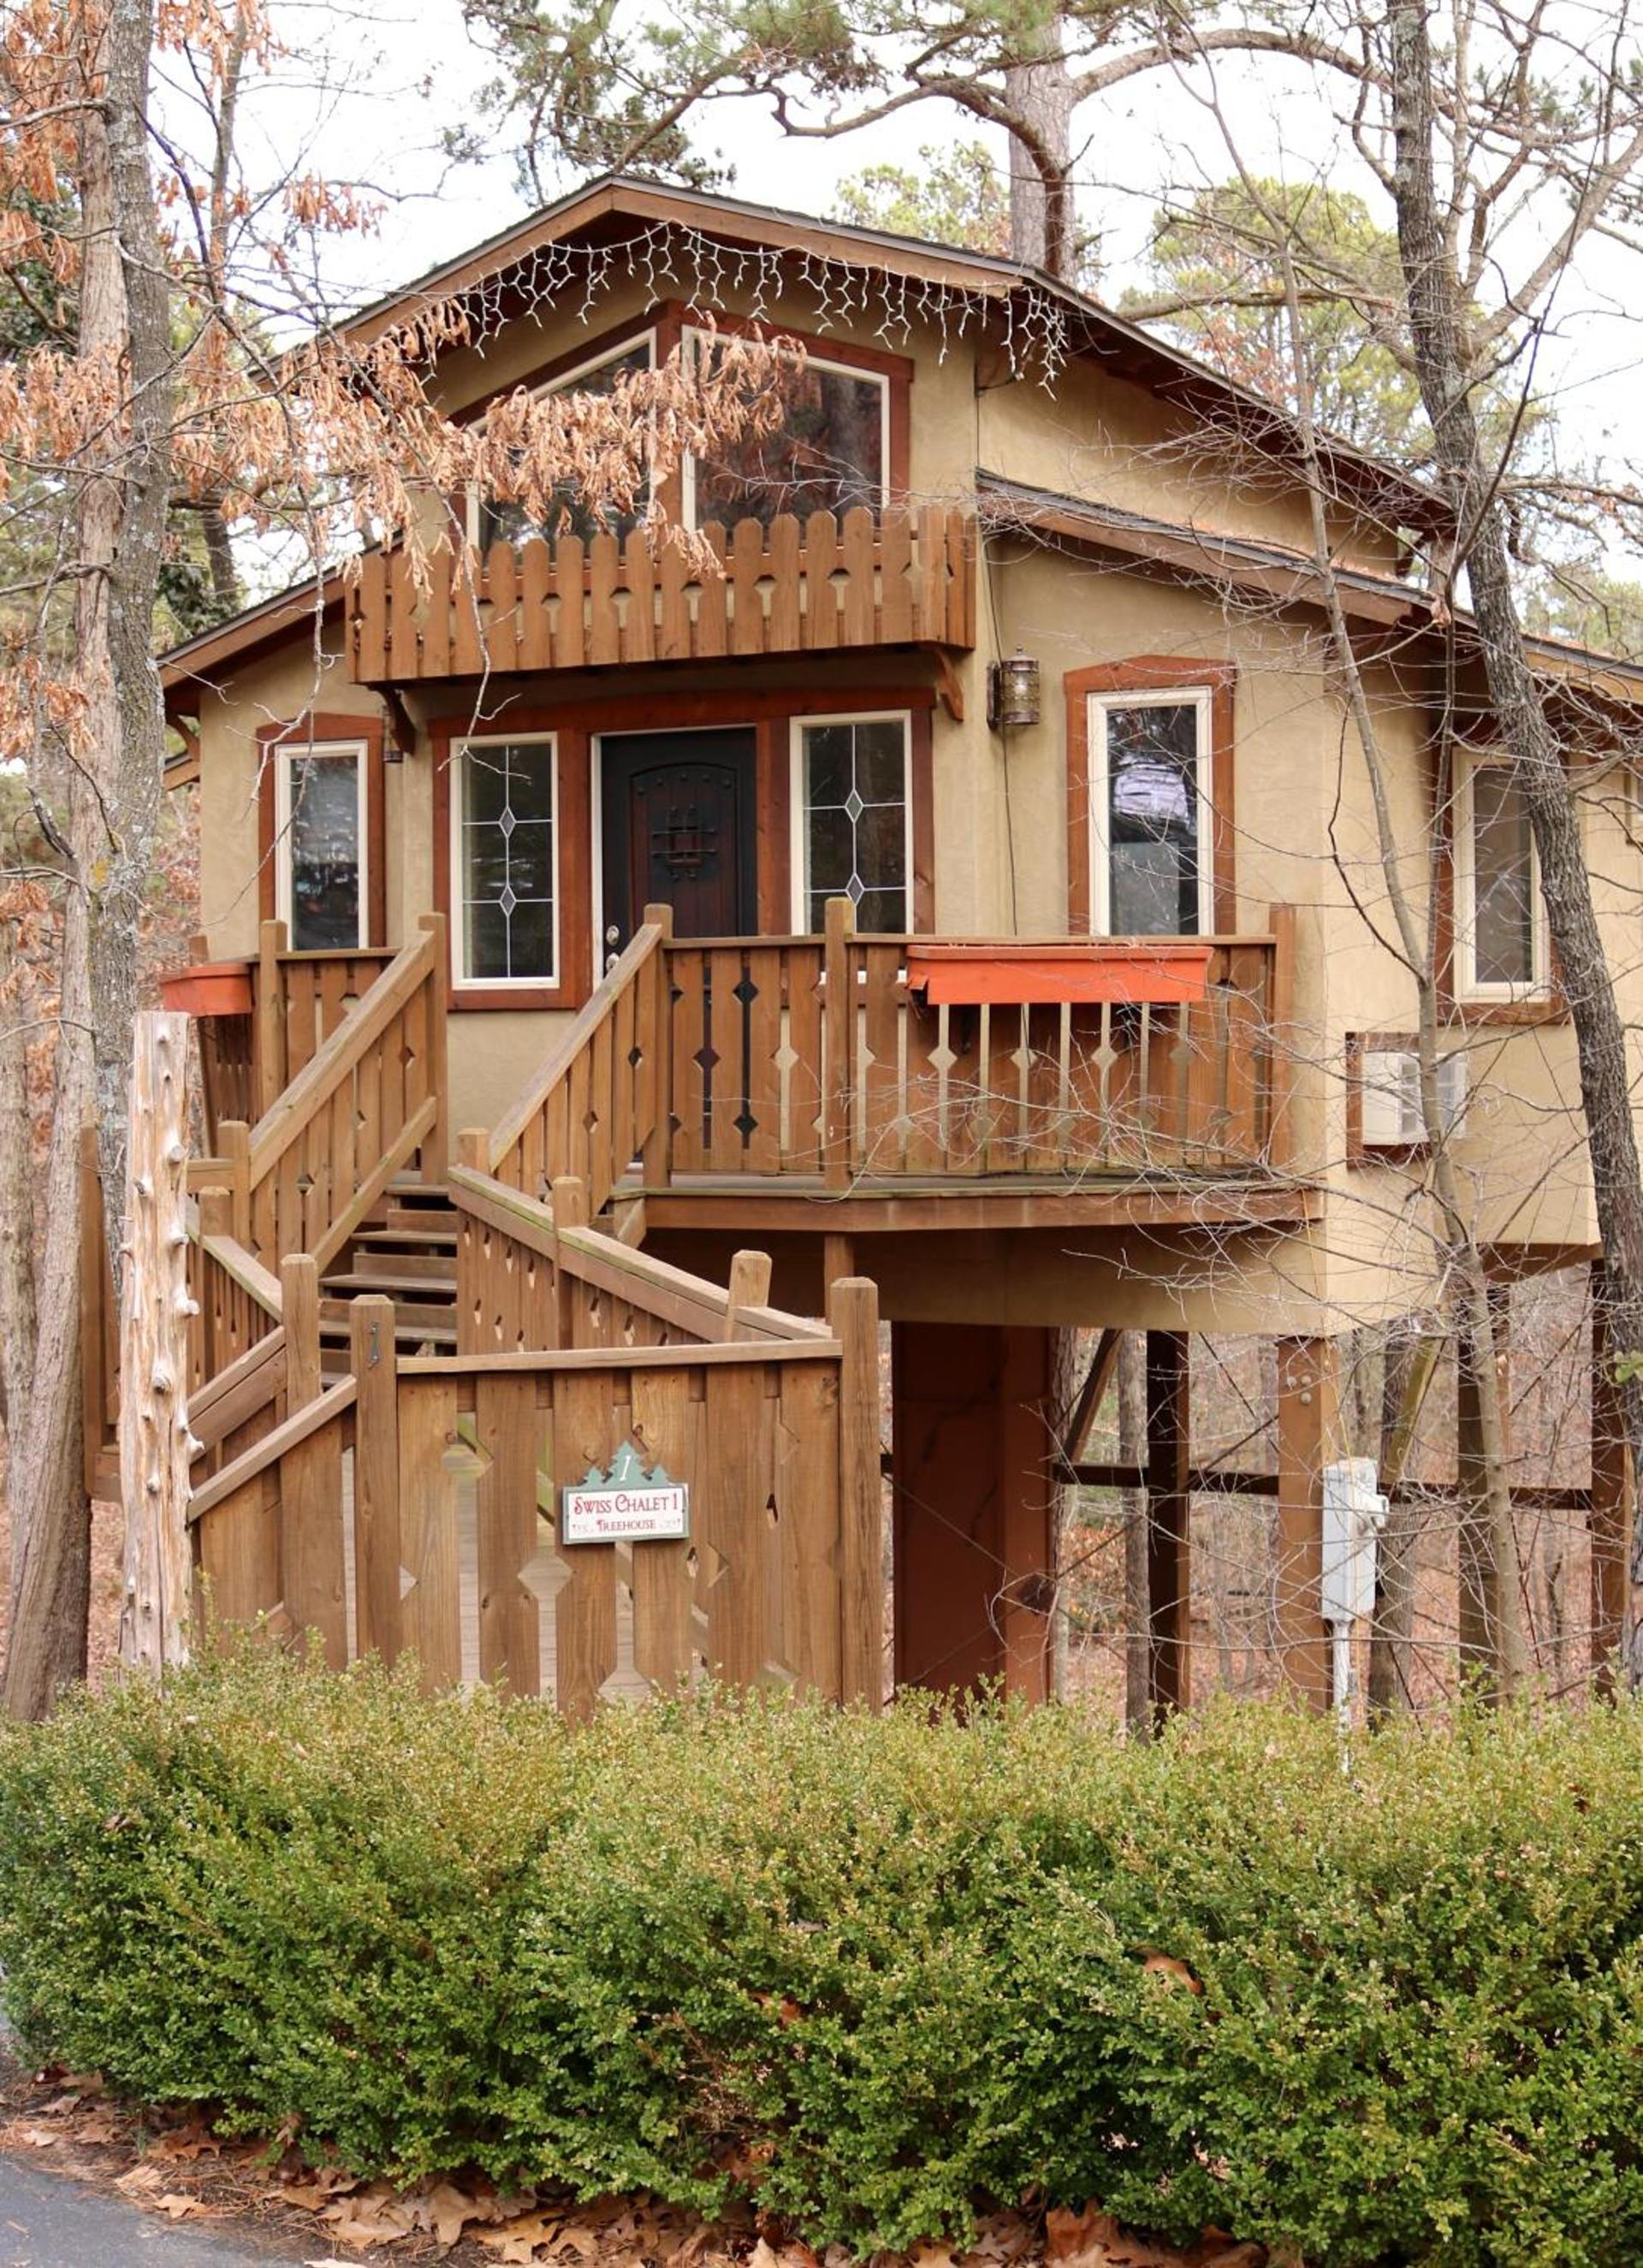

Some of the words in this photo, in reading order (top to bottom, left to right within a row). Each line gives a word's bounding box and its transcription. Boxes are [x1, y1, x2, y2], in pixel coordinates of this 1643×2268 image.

[574, 1496, 612, 1514] SWISS
[615, 1494, 669, 1513] CHALET
[596, 1519, 655, 1531] TREEHOUSE
